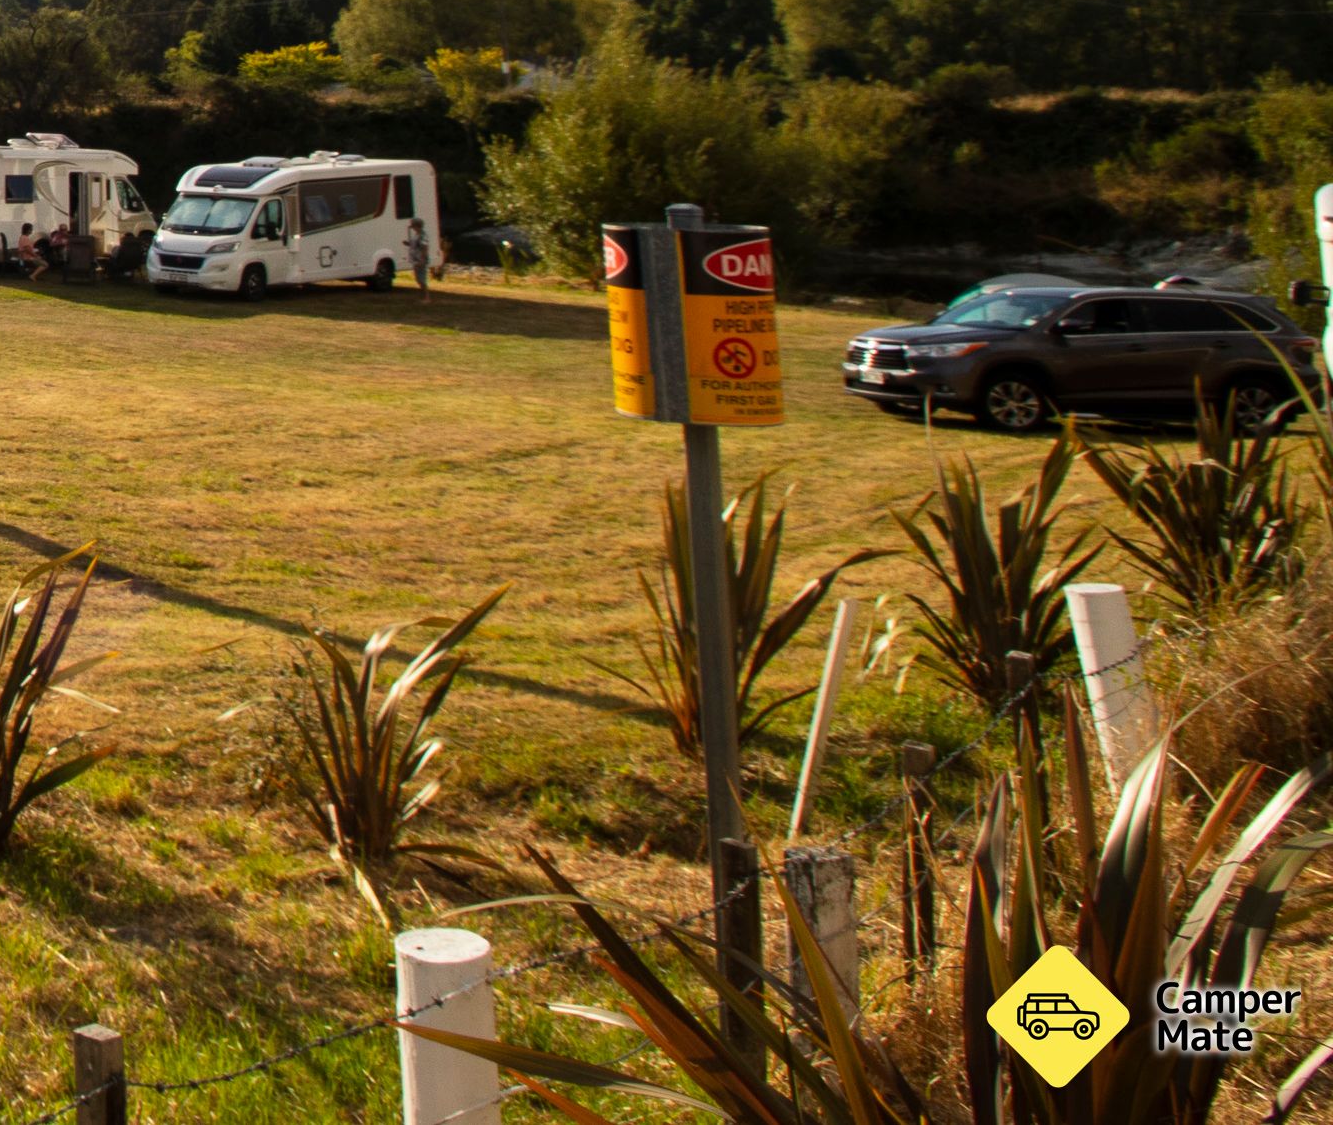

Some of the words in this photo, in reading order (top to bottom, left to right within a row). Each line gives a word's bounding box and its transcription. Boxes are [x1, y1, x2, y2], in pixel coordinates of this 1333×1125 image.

[713, 318, 767, 333] PIPELINE
[700, 379, 732, 391] FOR
[716, 394, 755, 406] FIRST
